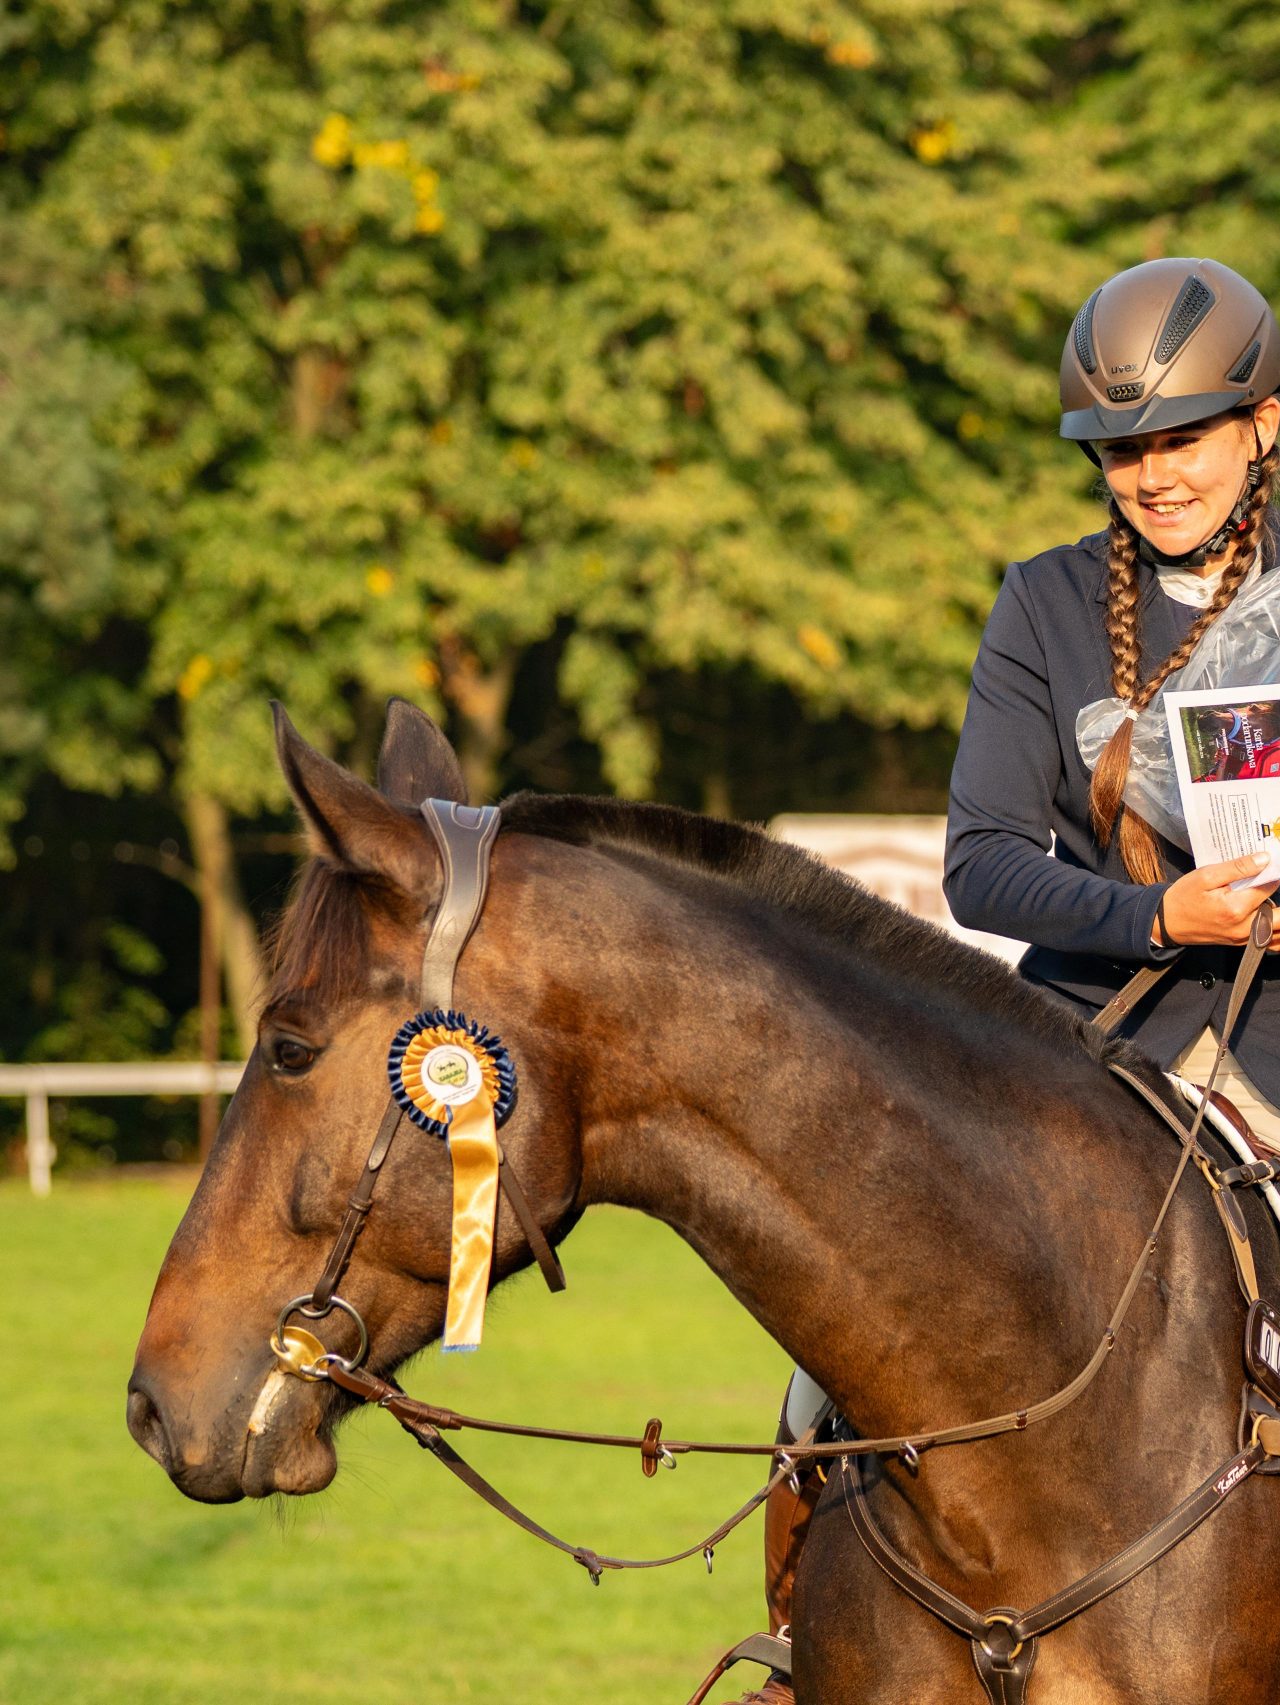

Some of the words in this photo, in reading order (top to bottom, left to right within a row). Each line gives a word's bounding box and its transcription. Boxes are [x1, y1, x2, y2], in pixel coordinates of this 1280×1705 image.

[1111, 364, 1138, 374] uvex
[1240, 712, 1256, 769] podarunkowa
[1255, 728, 1264, 751] Karta
